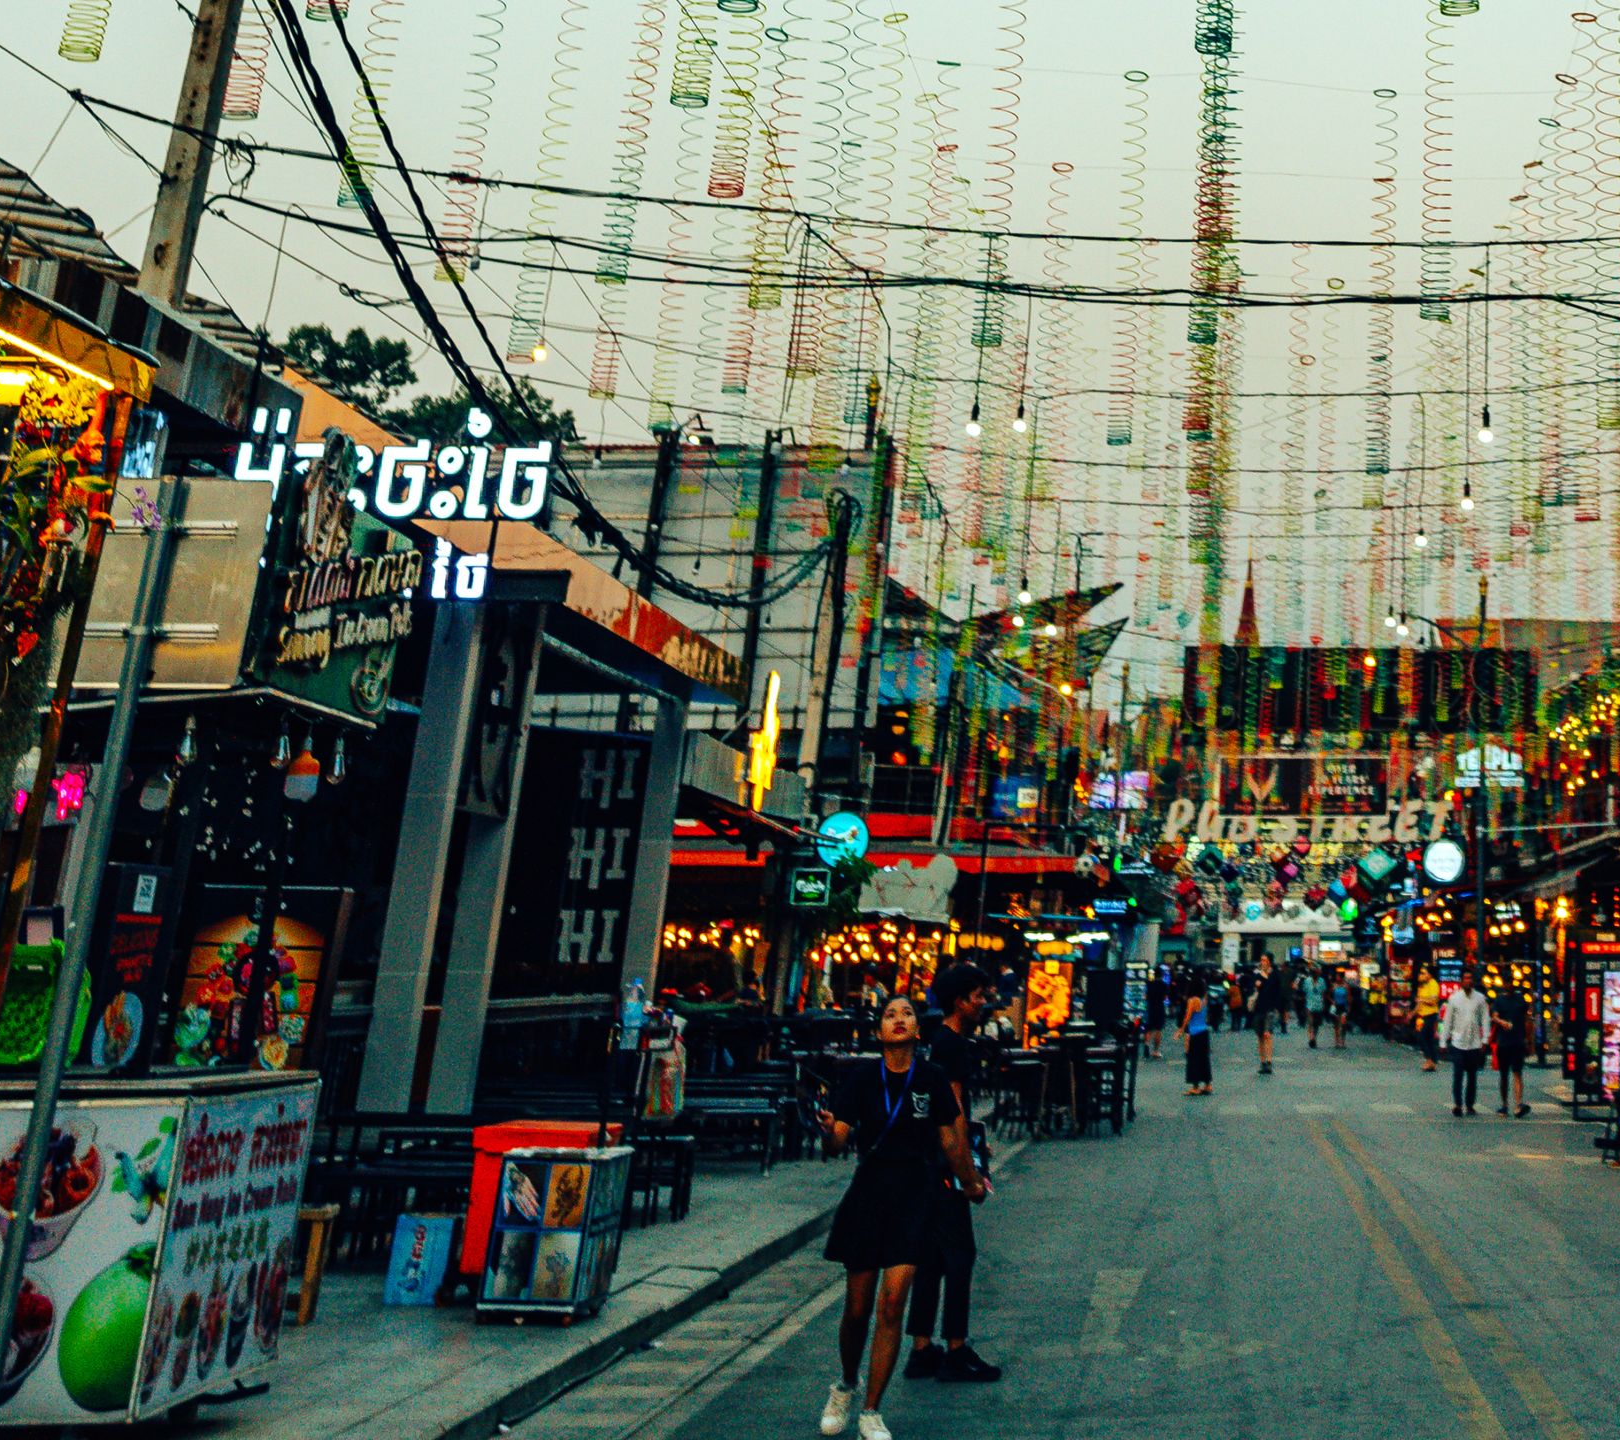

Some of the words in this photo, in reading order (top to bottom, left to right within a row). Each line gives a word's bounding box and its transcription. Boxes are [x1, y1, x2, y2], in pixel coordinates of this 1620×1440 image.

[580, 749, 641, 809] HI
[568, 827, 631, 890] HI
[557, 909, 620, 964] HI
